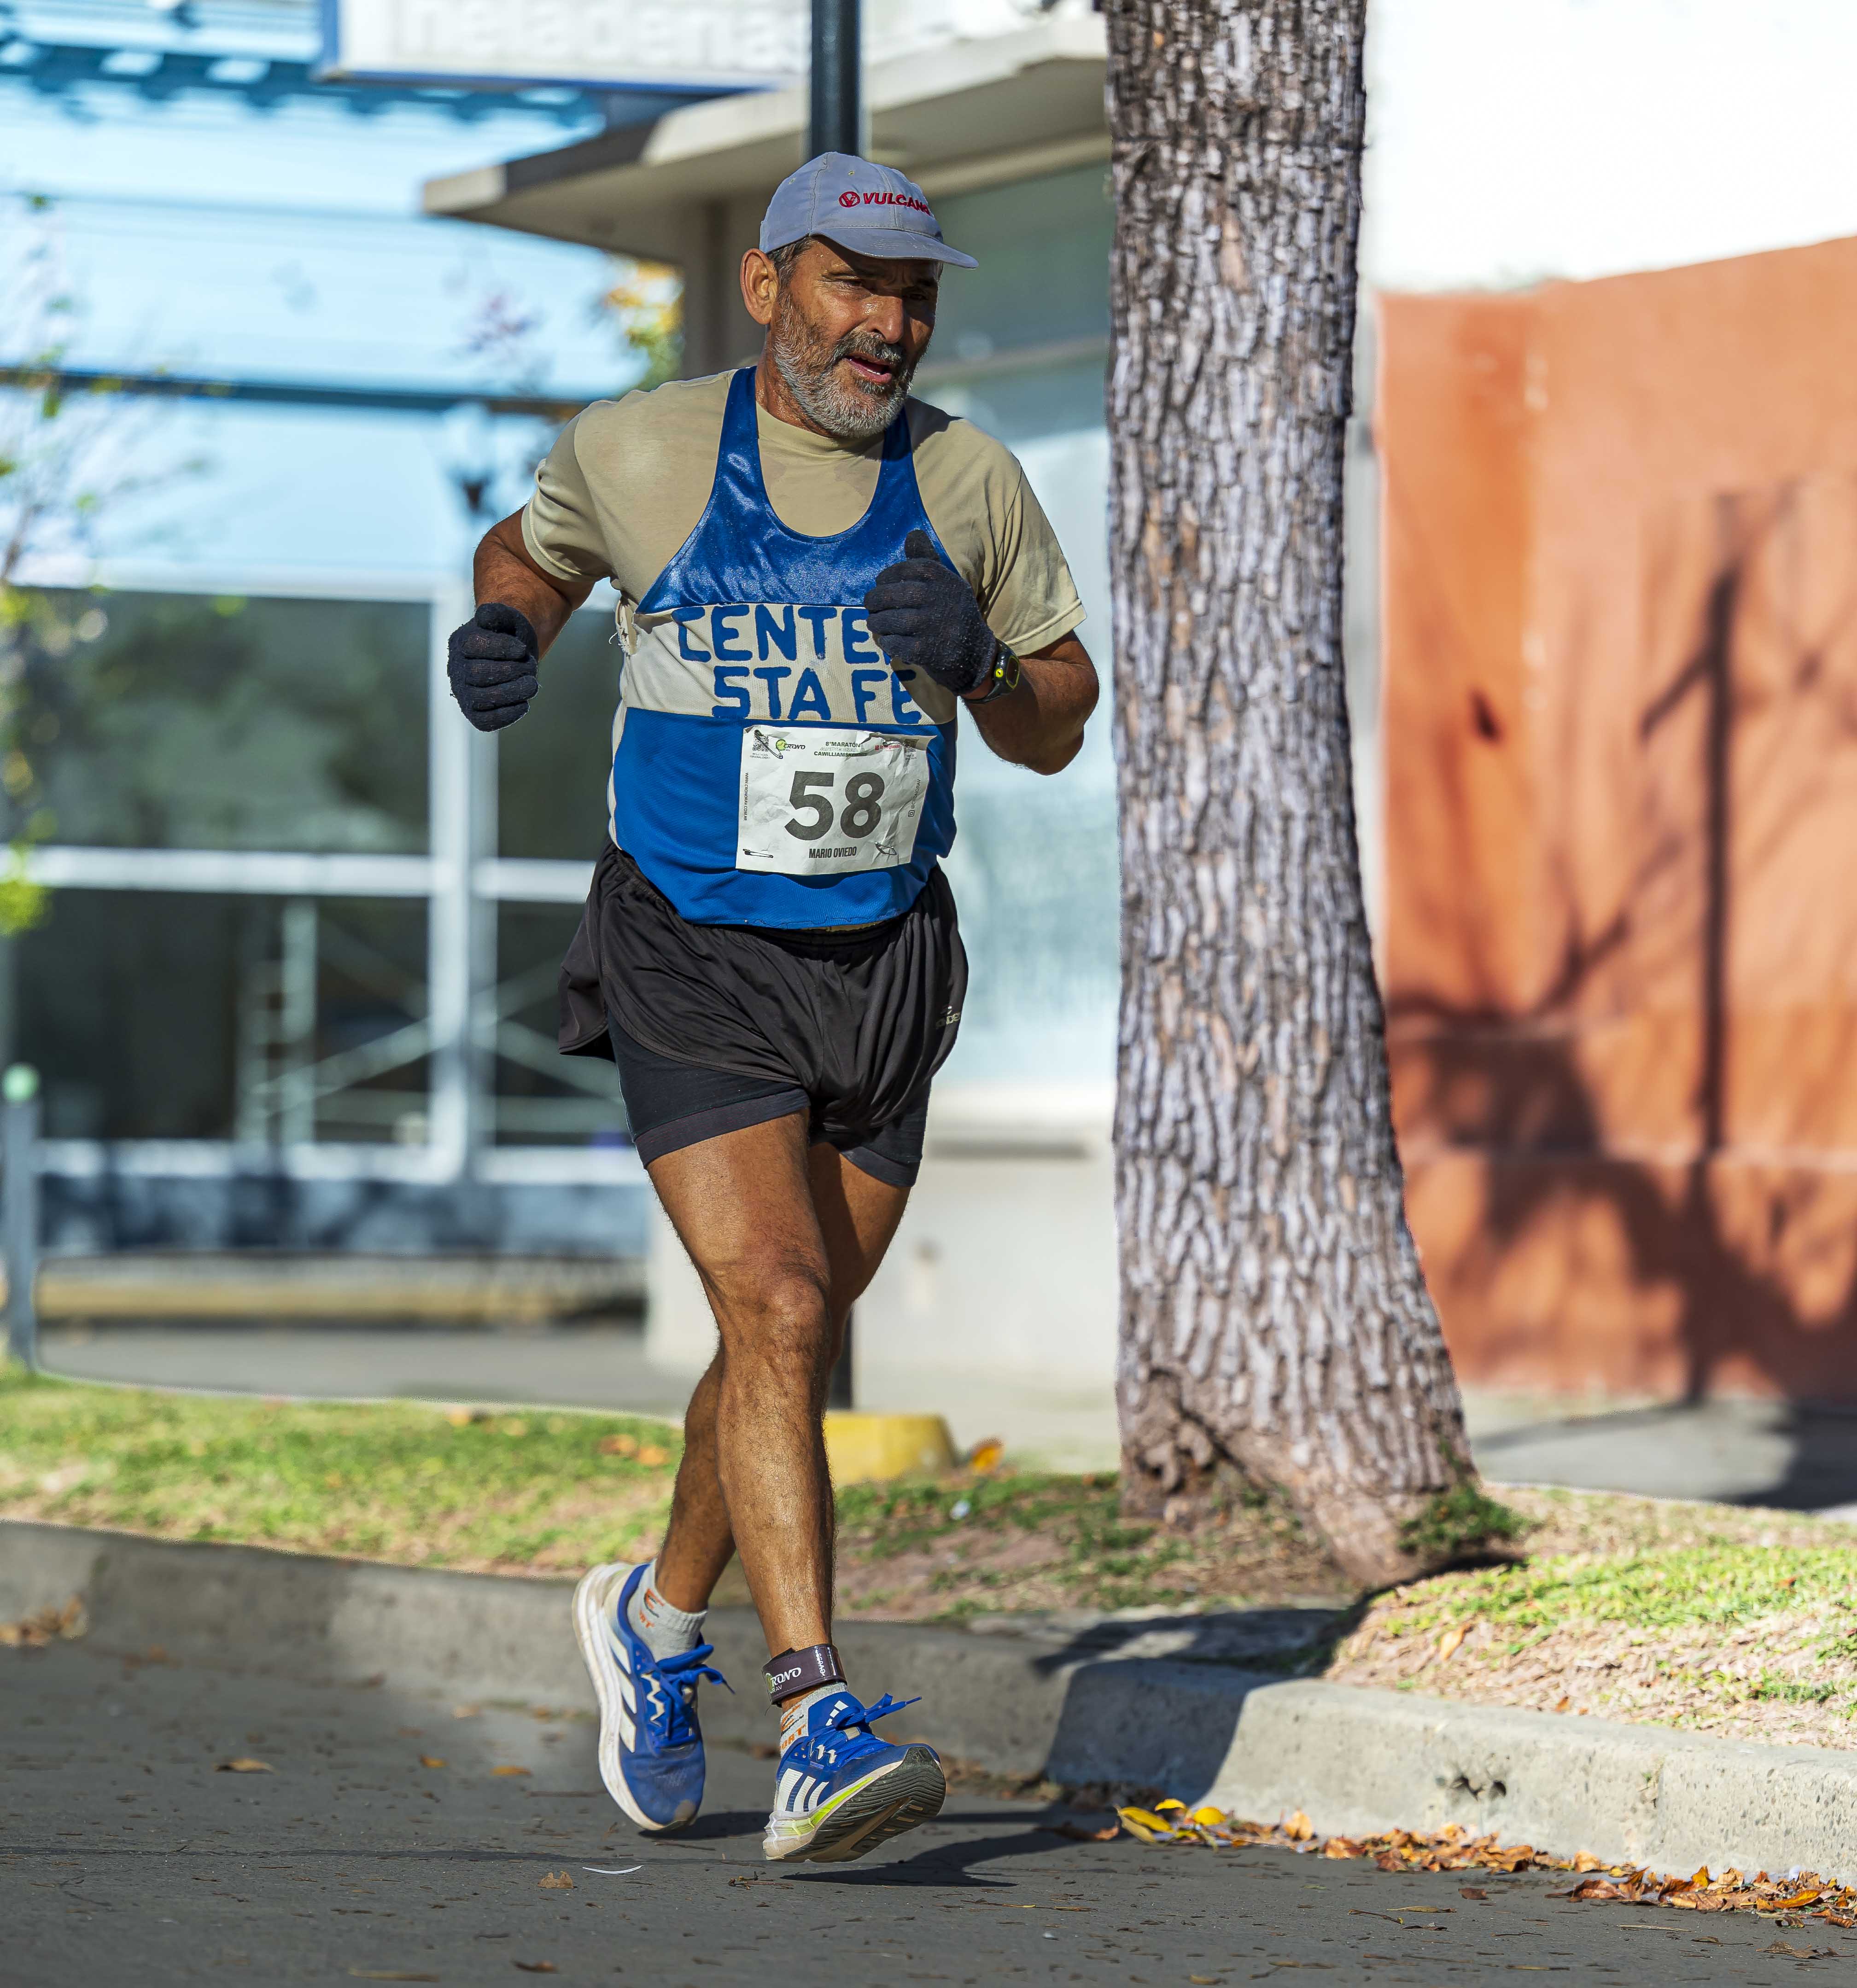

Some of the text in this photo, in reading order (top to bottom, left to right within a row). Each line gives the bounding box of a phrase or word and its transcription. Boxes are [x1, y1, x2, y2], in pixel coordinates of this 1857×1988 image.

[671, 604, 892, 663] CENTE
[712, 666, 922, 724] STA FE
[784, 771, 885, 841] 58
[809, 846, 857, 858] MARIO OVIEDO
